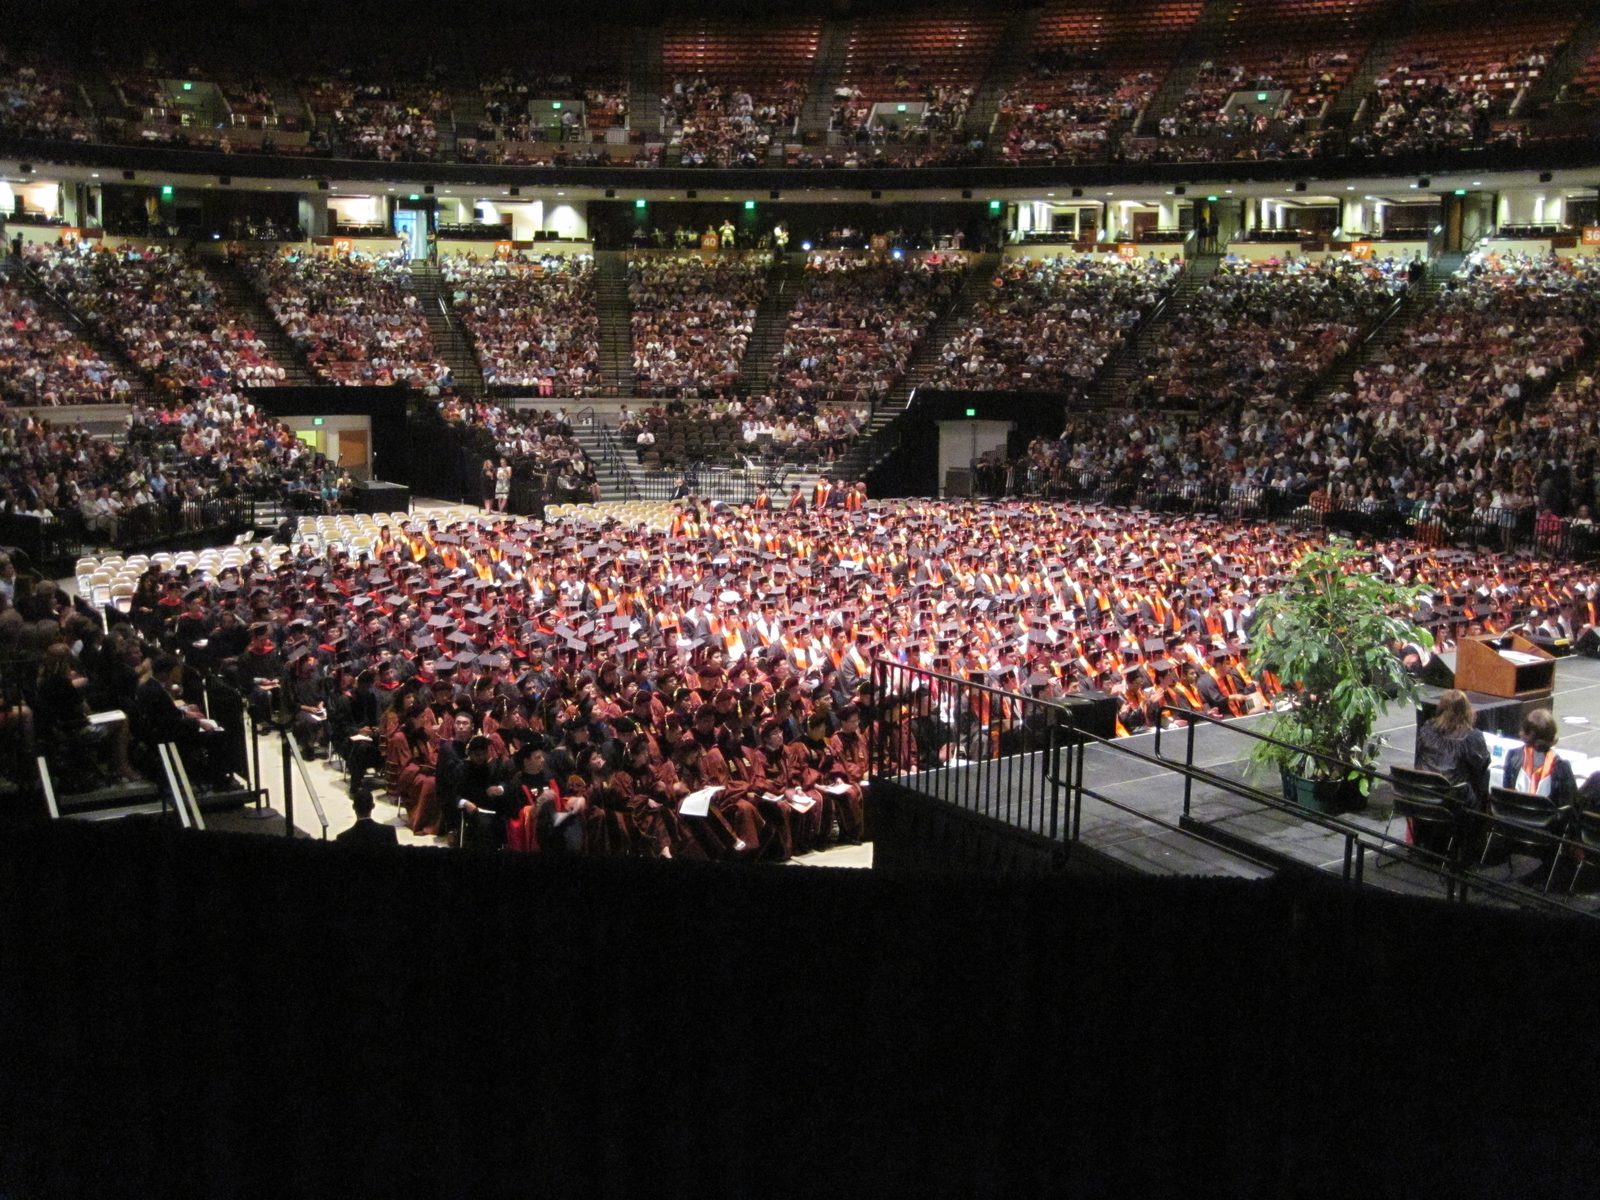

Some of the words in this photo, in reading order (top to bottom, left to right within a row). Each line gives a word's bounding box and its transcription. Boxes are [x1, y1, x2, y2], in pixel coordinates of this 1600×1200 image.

[1585, 230, 1600, 241] 36
[335, 240, 350, 251] 42
[703, 238, 716, 247] 40
